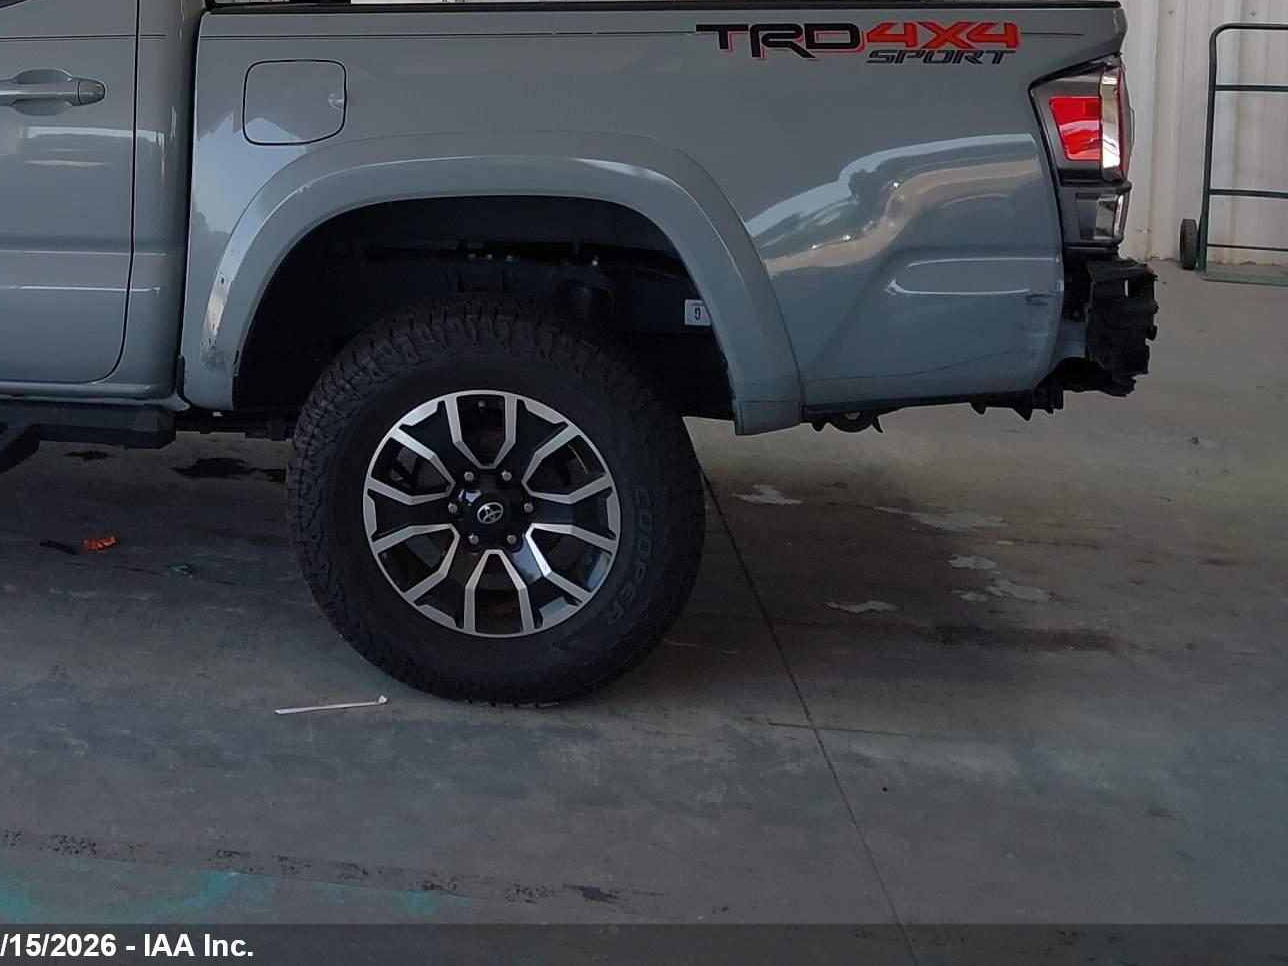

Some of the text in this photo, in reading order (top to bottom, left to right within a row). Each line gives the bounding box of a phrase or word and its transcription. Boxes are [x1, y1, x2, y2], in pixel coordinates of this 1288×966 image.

[696, 23, 865, 59] TRD
[867, 49, 1015, 64] SPORT
[606, 487, 657, 625] COOPER
